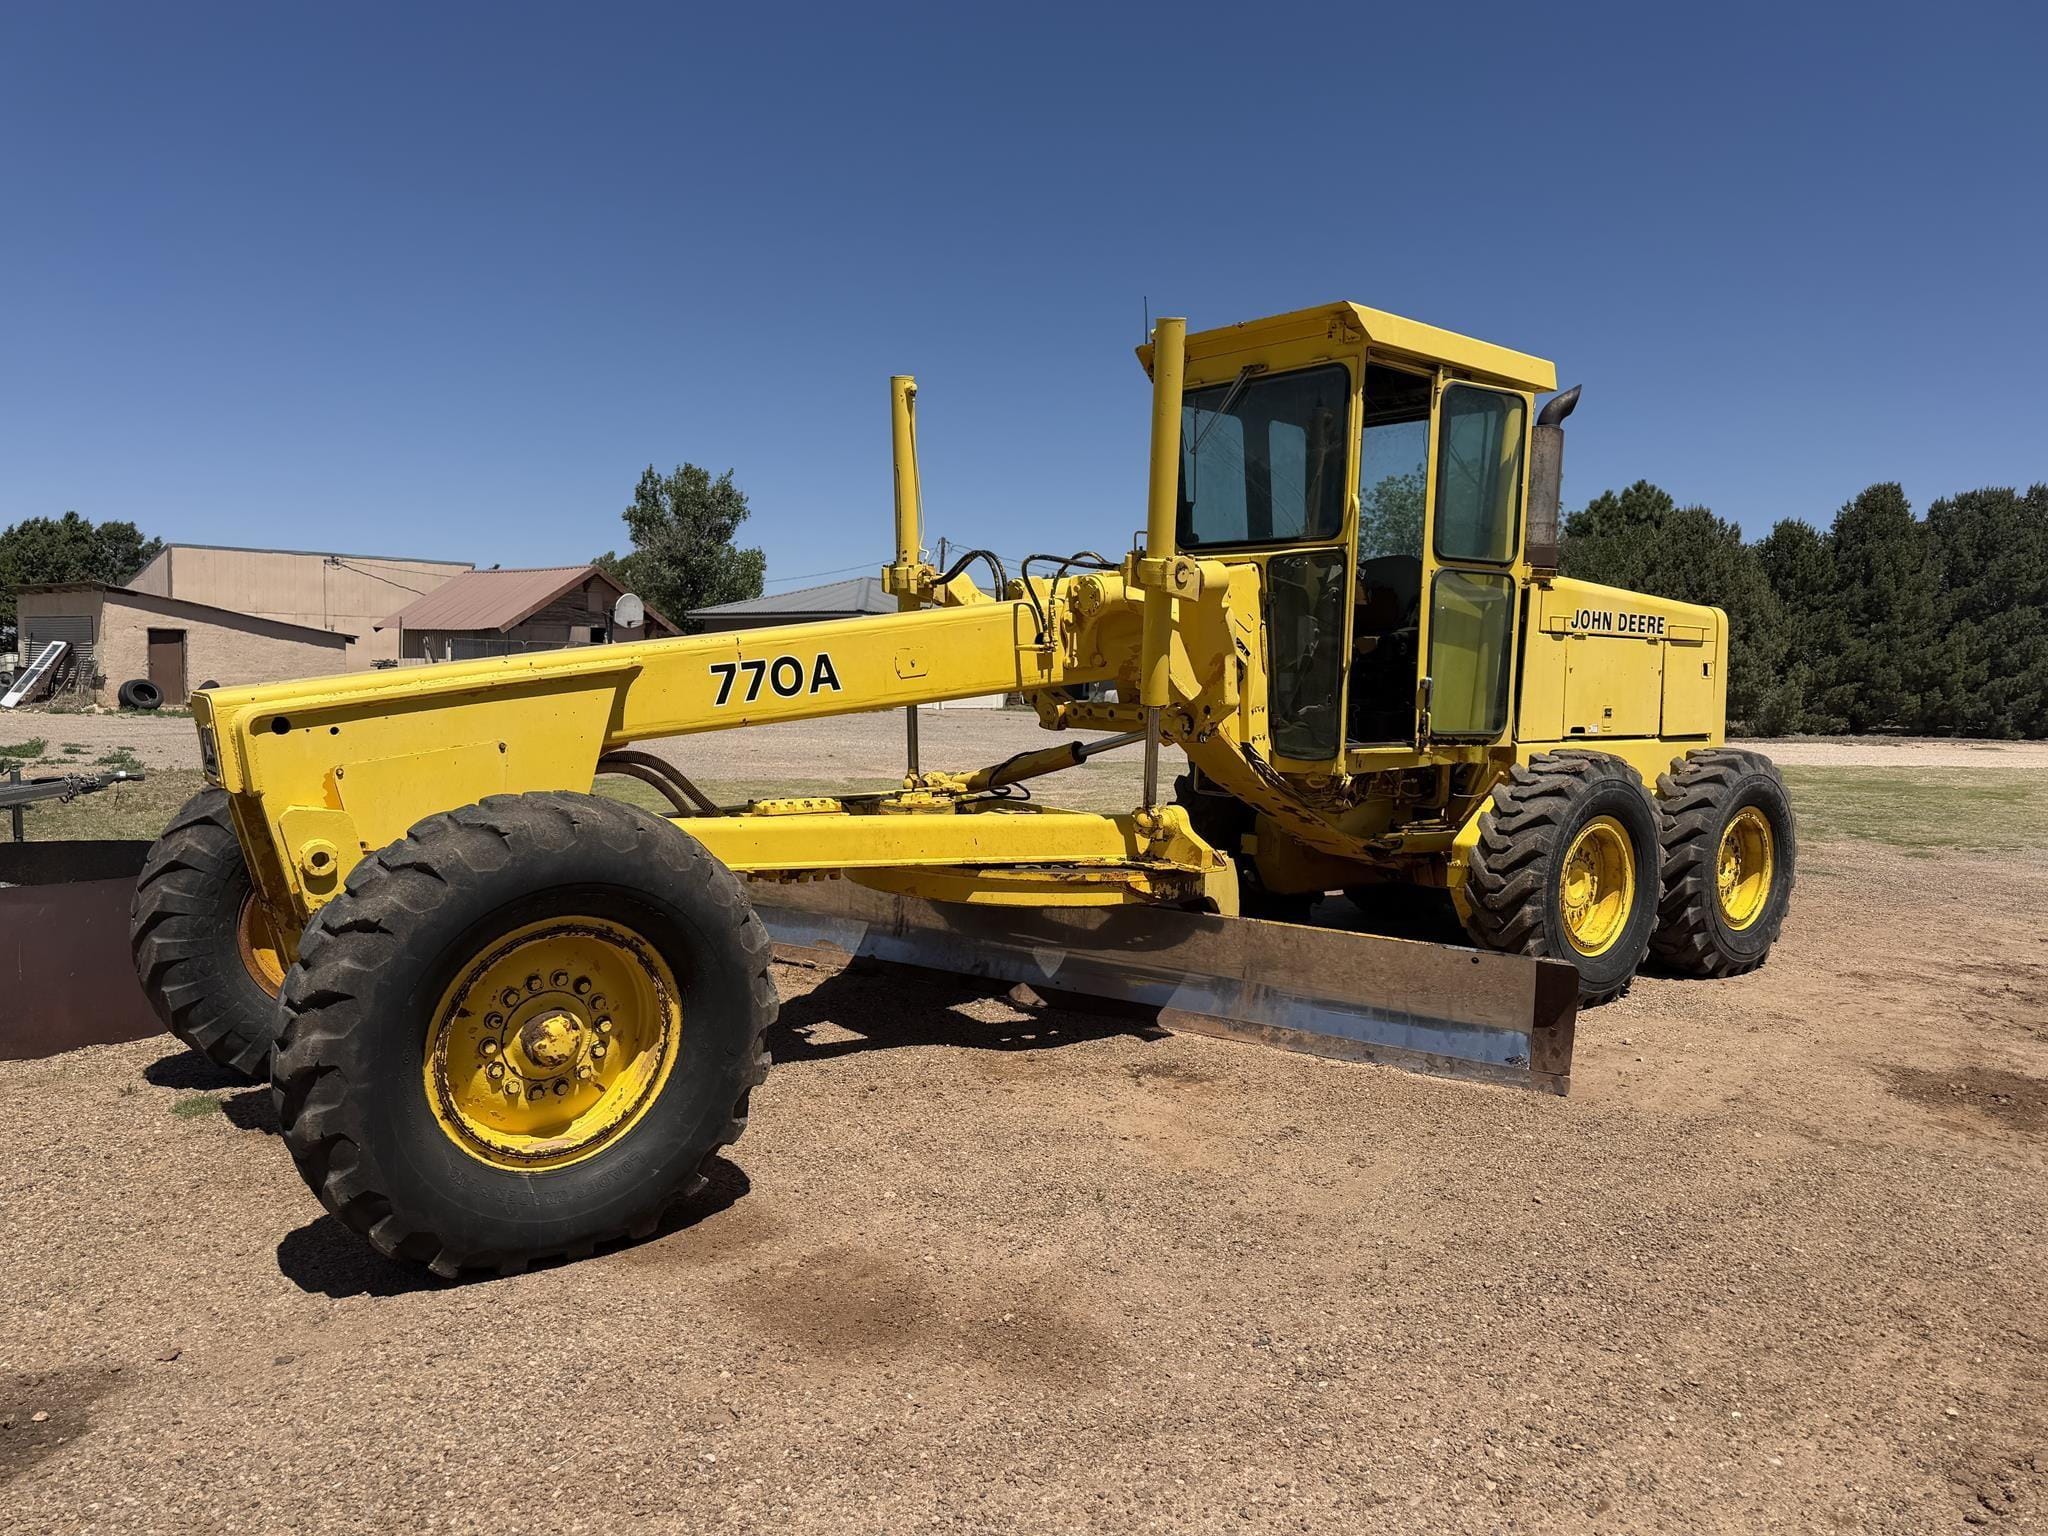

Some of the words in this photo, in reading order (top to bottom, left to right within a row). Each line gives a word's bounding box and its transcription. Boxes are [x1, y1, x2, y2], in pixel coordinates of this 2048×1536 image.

[1571, 609, 1613, 631] JOHN
[1618, 613, 1665, 635] DEERE
[710, 653, 842, 706] 770A
